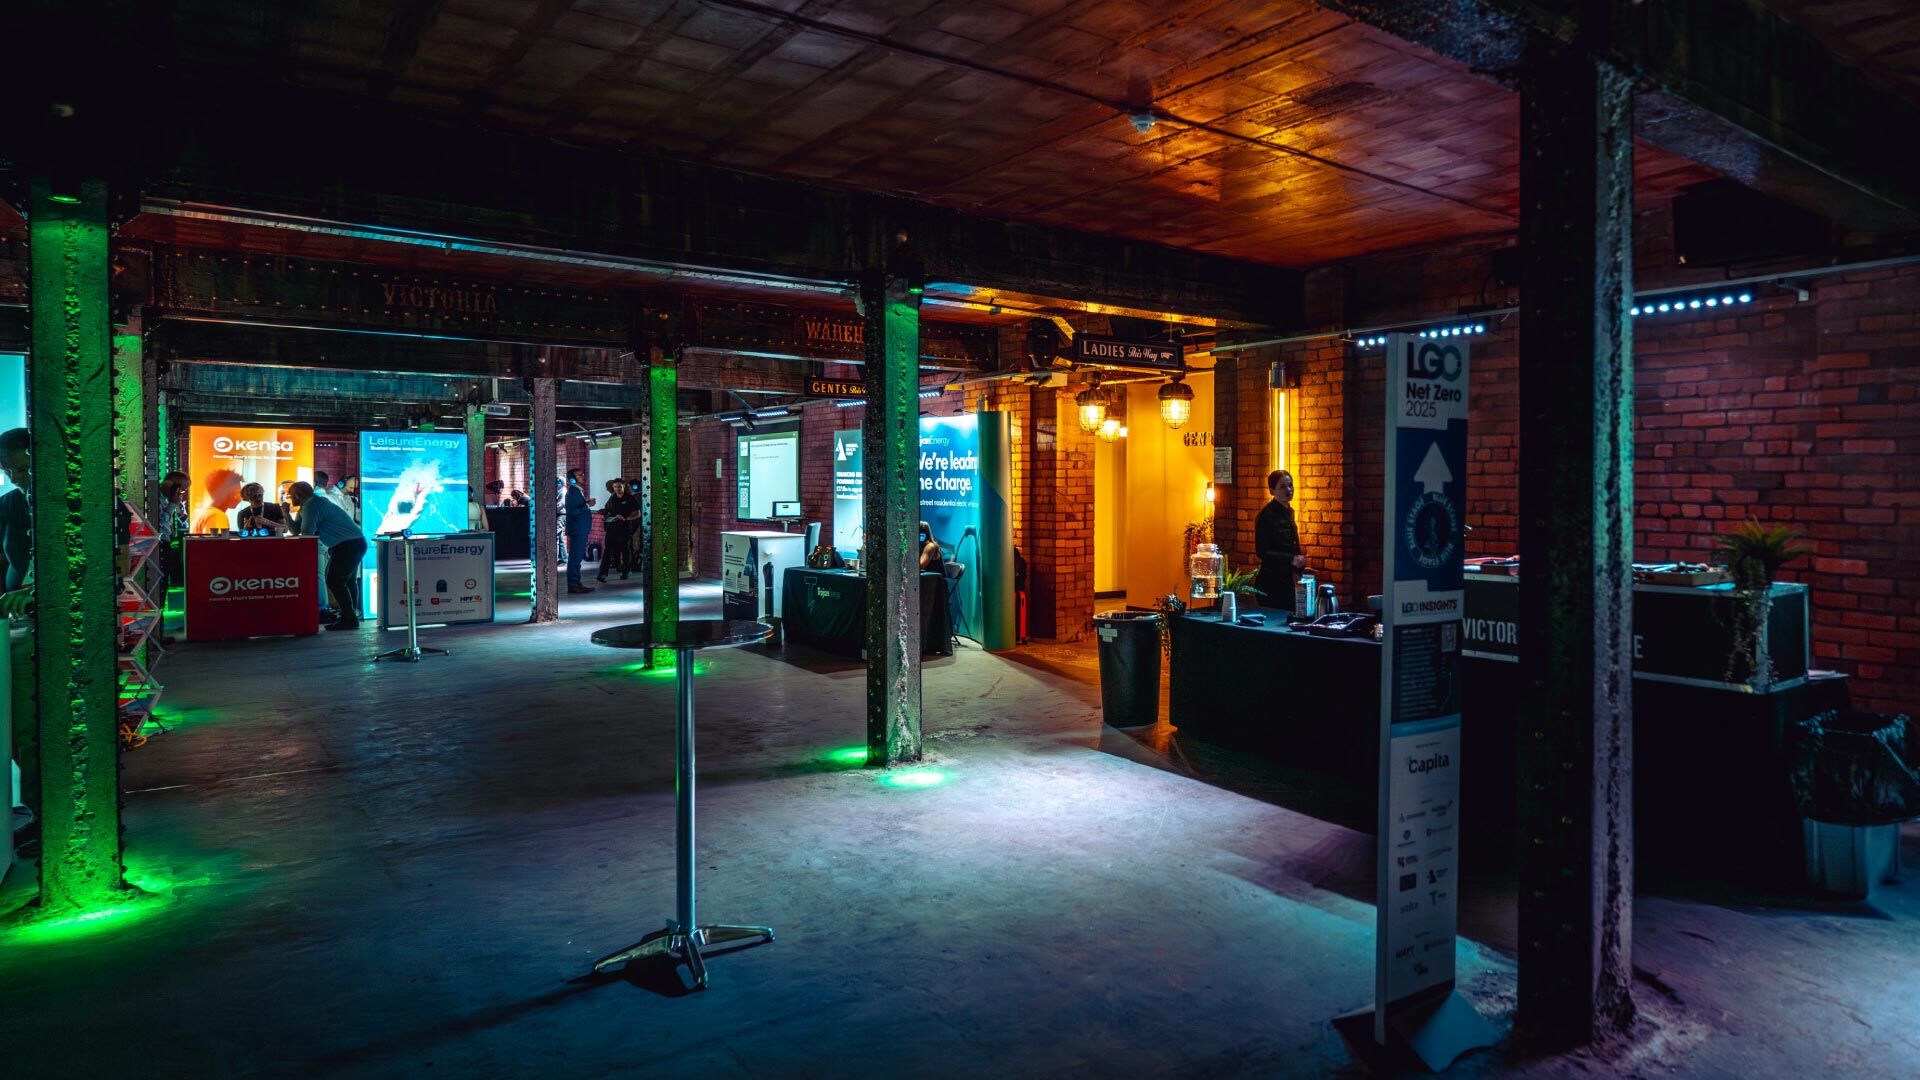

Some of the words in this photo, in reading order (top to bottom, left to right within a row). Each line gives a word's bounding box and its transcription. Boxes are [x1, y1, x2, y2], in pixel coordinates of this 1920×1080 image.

[382, 283, 497, 312] VICTORIA
[806, 320, 865, 343] WAREH
[1083, 340, 1125, 358] LADIES
[1128, 346, 1142, 358] This
[1143, 348, 1158, 362] Way
[1407, 342, 1462, 382] LGO
[812, 382, 847, 394] GENTS
[1406, 382, 1430, 399] Net
[1433, 384, 1462, 402] Zero
[1406, 401, 1437, 418] 2025
[369, 436, 461, 449] LeisureEnergy
[935, 470, 973, 496] charge.
[395, 544, 485, 556] LsureEnergy
[1419, 599, 1457, 613] INSIGHTS
[1461, 617, 1518, 645] VICTOR
[1408, 753, 1451, 776] Capita
